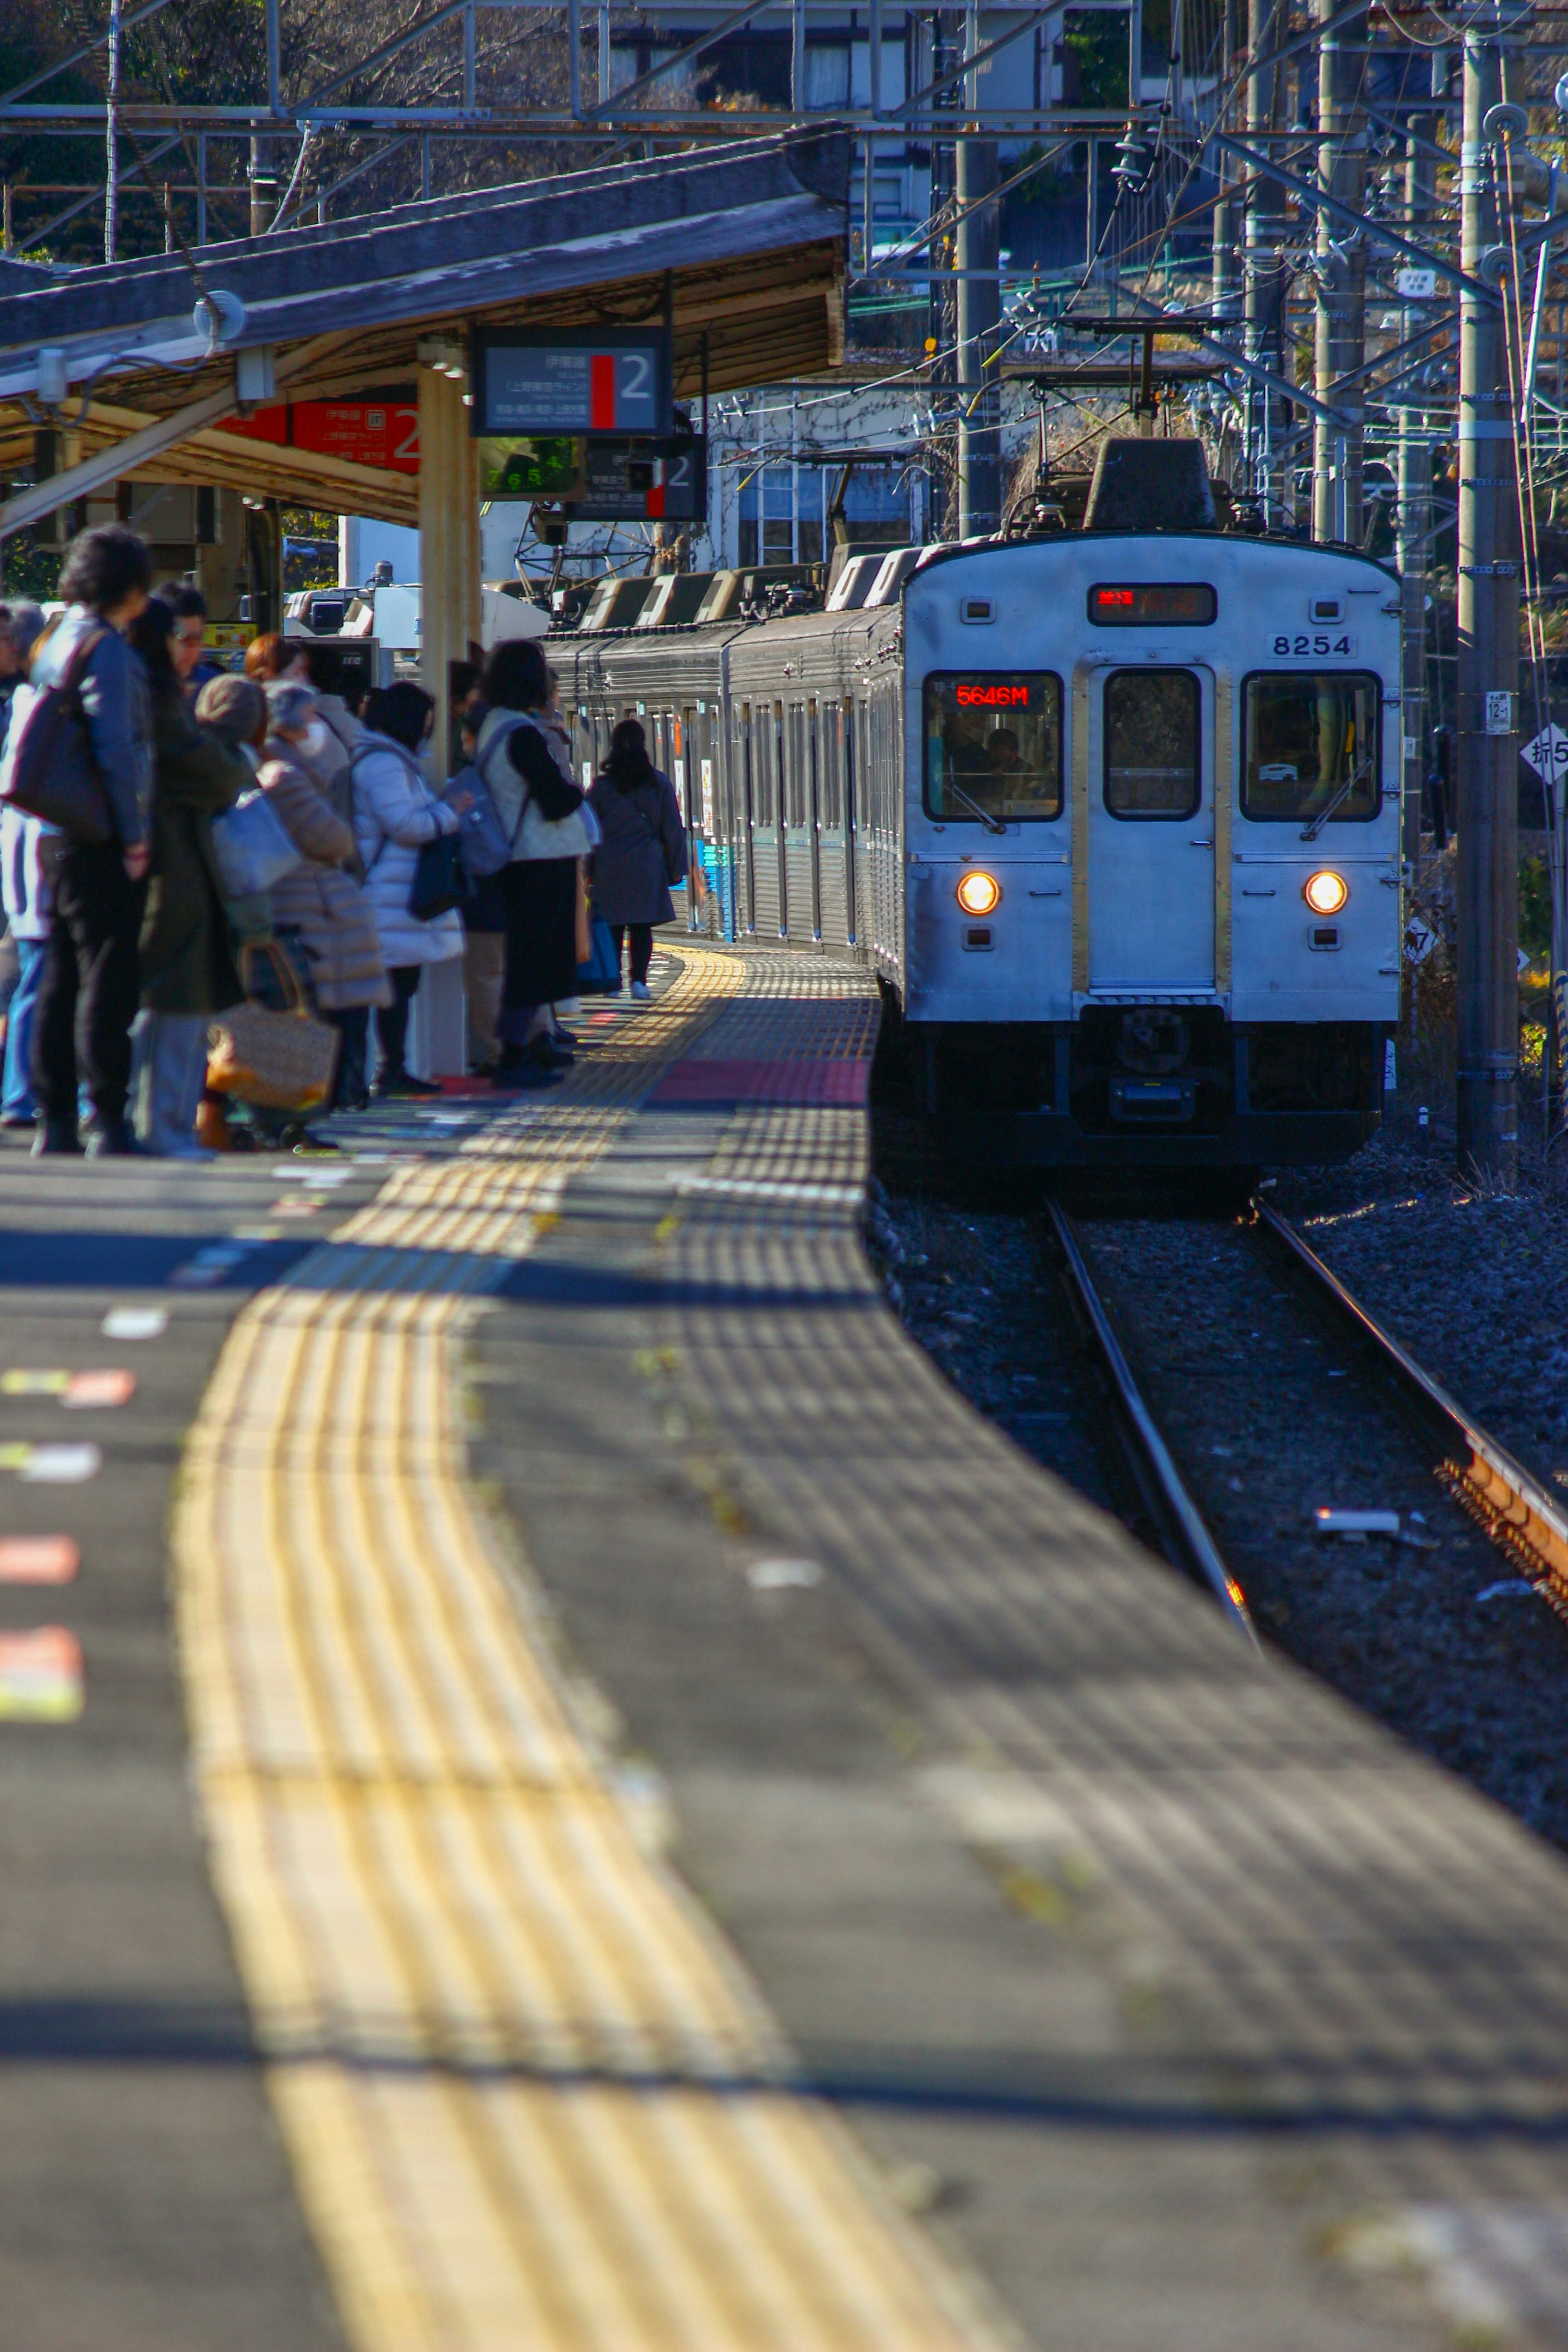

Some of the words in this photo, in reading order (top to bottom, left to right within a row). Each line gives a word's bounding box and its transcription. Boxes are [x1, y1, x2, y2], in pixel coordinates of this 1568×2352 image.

[621, 355, 650, 398] 2
[370, 416, 380, 424] JT
[394, 409, 419, 458] 2
[508, 473, 520, 486] 6
[528, 468, 540, 482] 5
[669, 455, 689, 486] 2
[1273, 636, 1350, 655] 8254
[957, 685, 1029, 706] 5646M
[1489, 704, 1509, 719] 12-1
